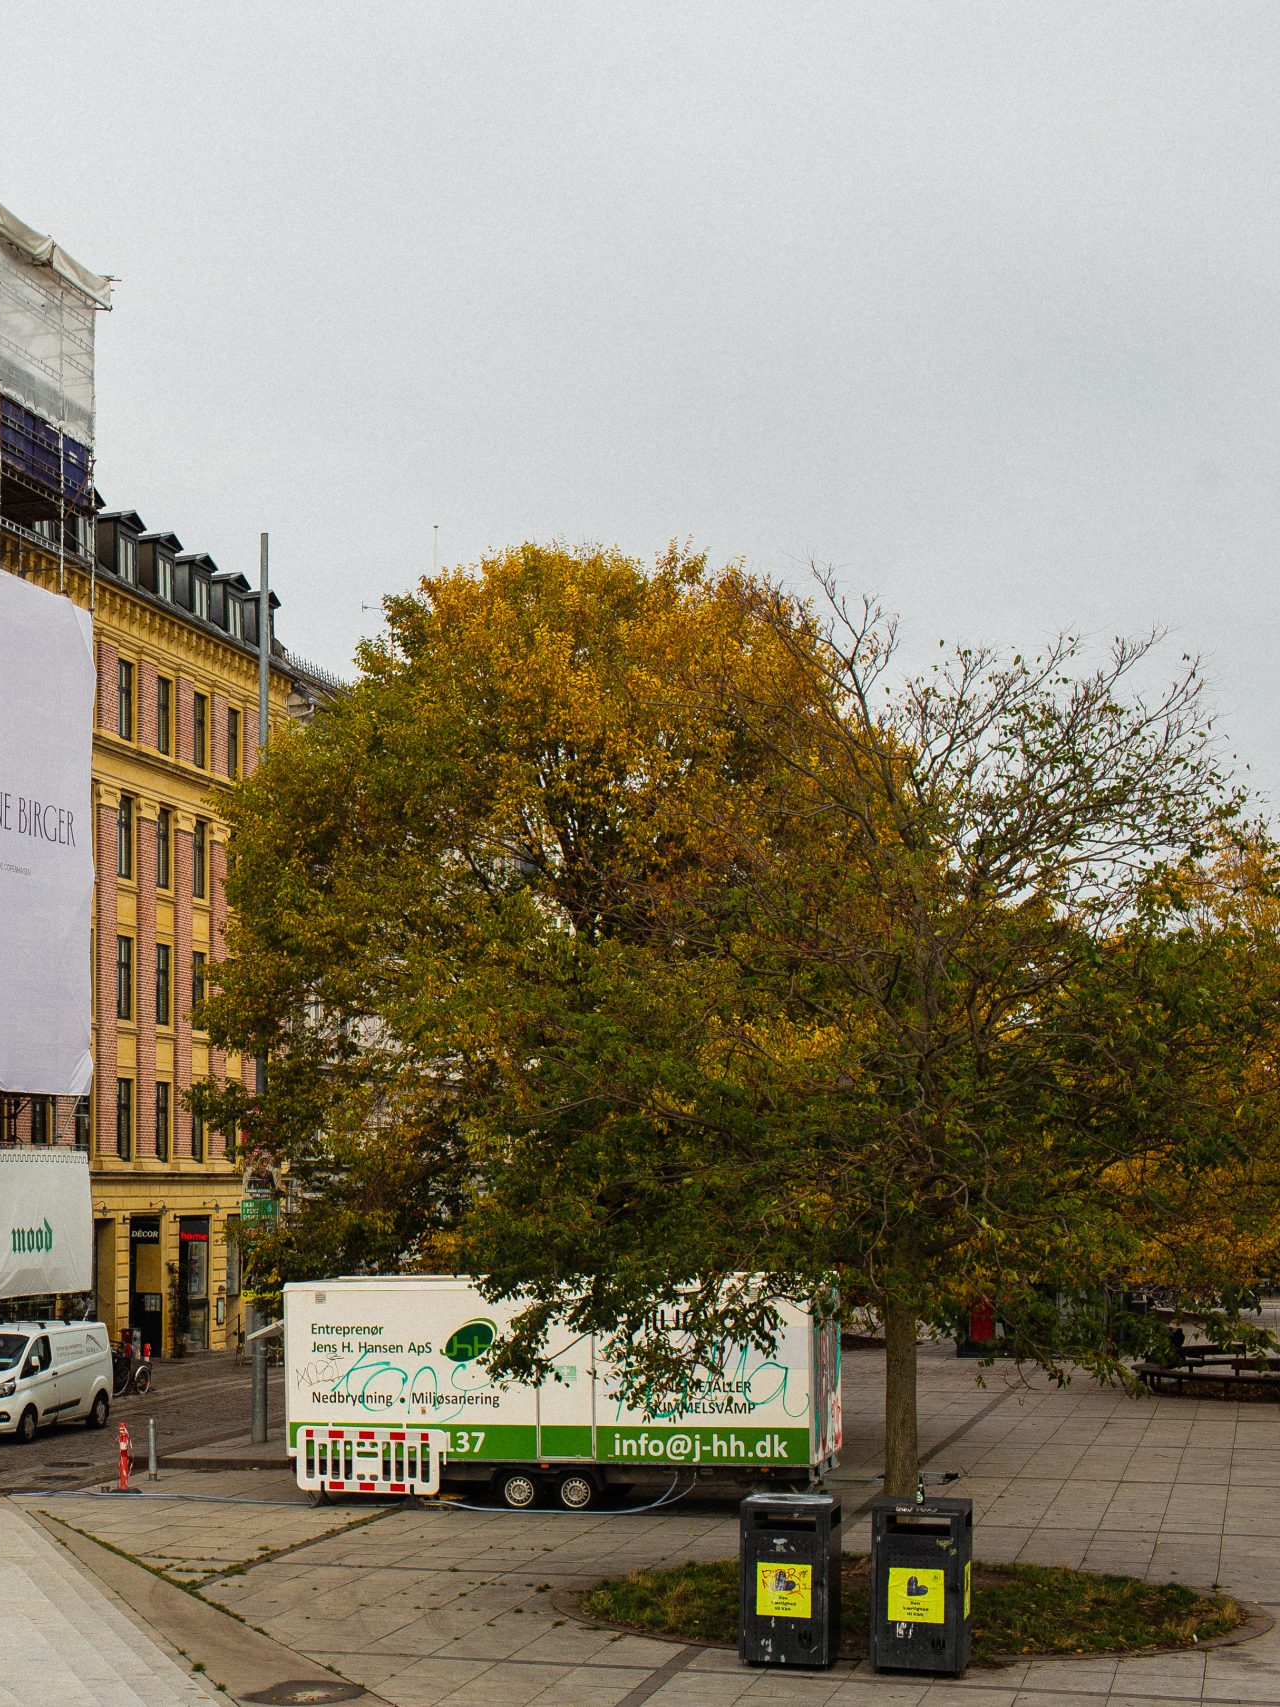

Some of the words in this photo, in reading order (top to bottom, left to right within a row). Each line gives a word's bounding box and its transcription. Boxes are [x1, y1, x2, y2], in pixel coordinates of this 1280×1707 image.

[18, 796, 76, 848] BIRGER
[11, 1217, 54, 1254] mood
[131, 1228, 159, 1238] DÉCOR
[180, 1231, 208, 1242] home
[311, 1323, 384, 1338] Entreprenør
[311, 1341, 338, 1354] Jens
[341, 1341, 354, 1354] H.
[358, 1341, 404, 1354] Hansen
[407, 1341, 432, 1357] ApS
[311, 1391, 393, 1407] Nedbrydning
[412, 1391, 500, 1408] Miljøsanering
[613, 1433, 788, 1463] info@j-hh.dk
